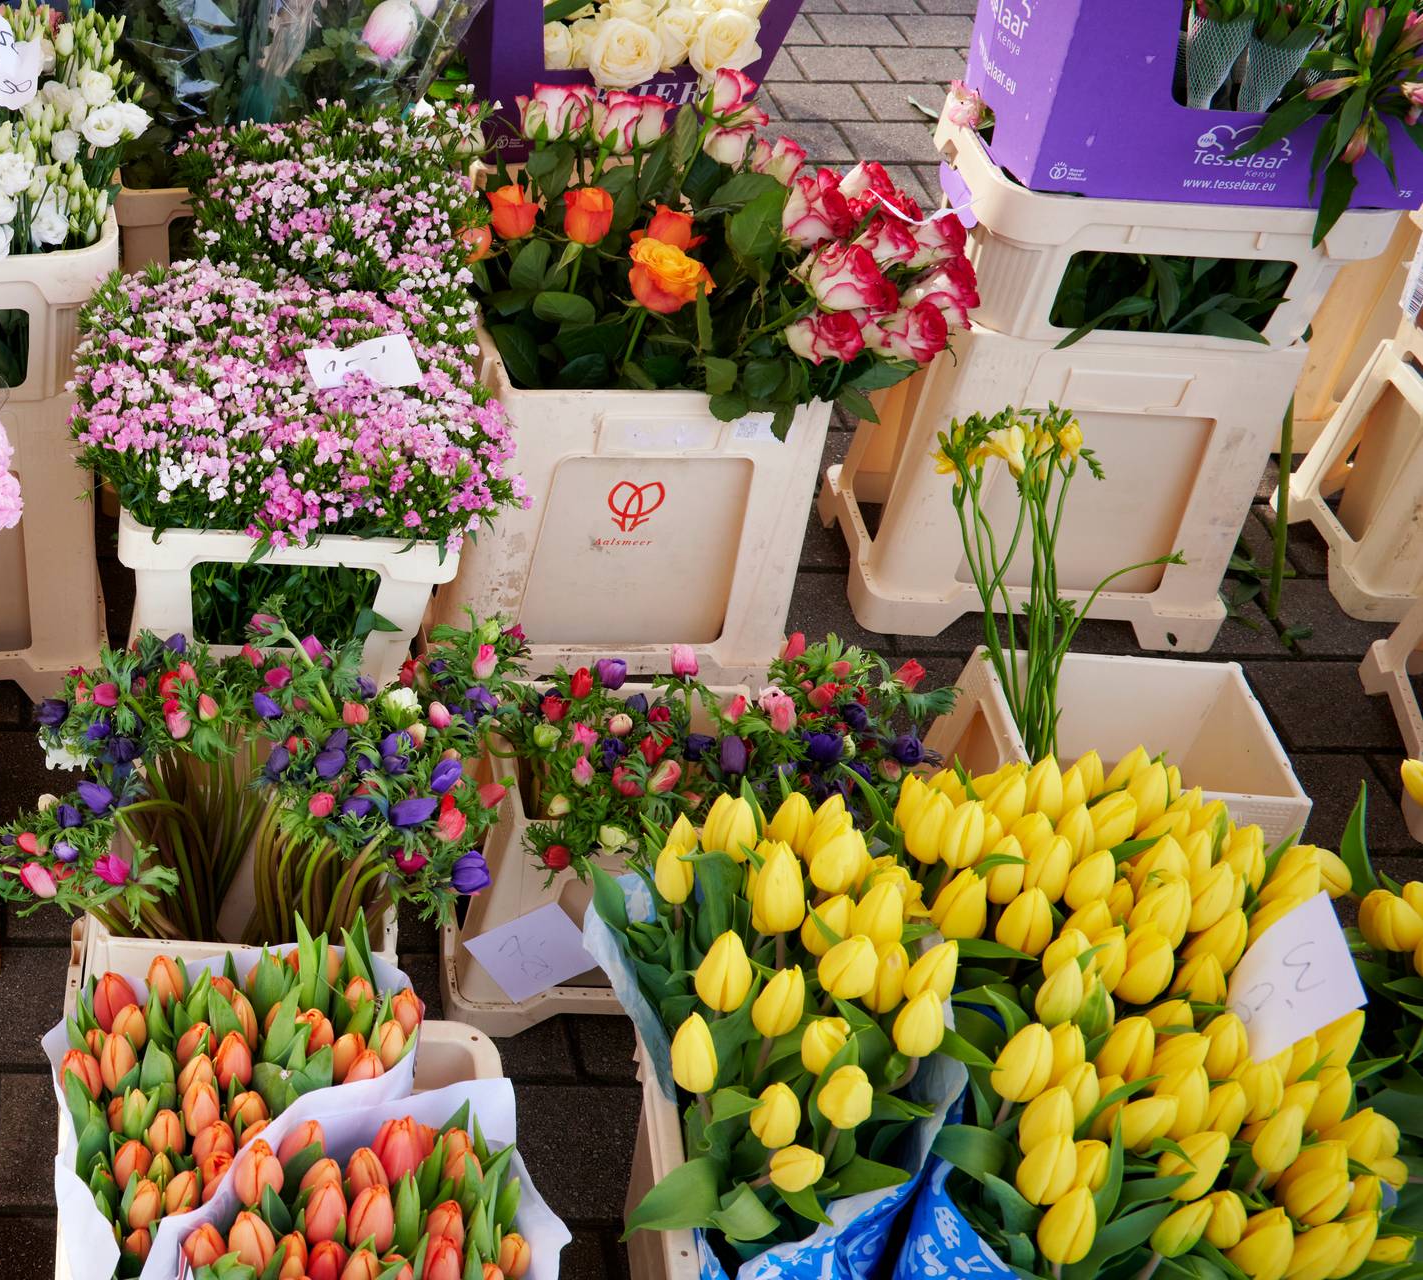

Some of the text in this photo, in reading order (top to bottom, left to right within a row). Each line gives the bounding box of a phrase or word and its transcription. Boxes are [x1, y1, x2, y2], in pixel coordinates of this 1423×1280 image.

[997, 31, 1020, 56] Kenya
[1193, 149, 1288, 169] Tesselaar
[1244, 169, 1276, 179] Kenya
[1182, 179, 1277, 192] www.tesselaar.eu
[594, 537, 653, 547] Aalsmeer
